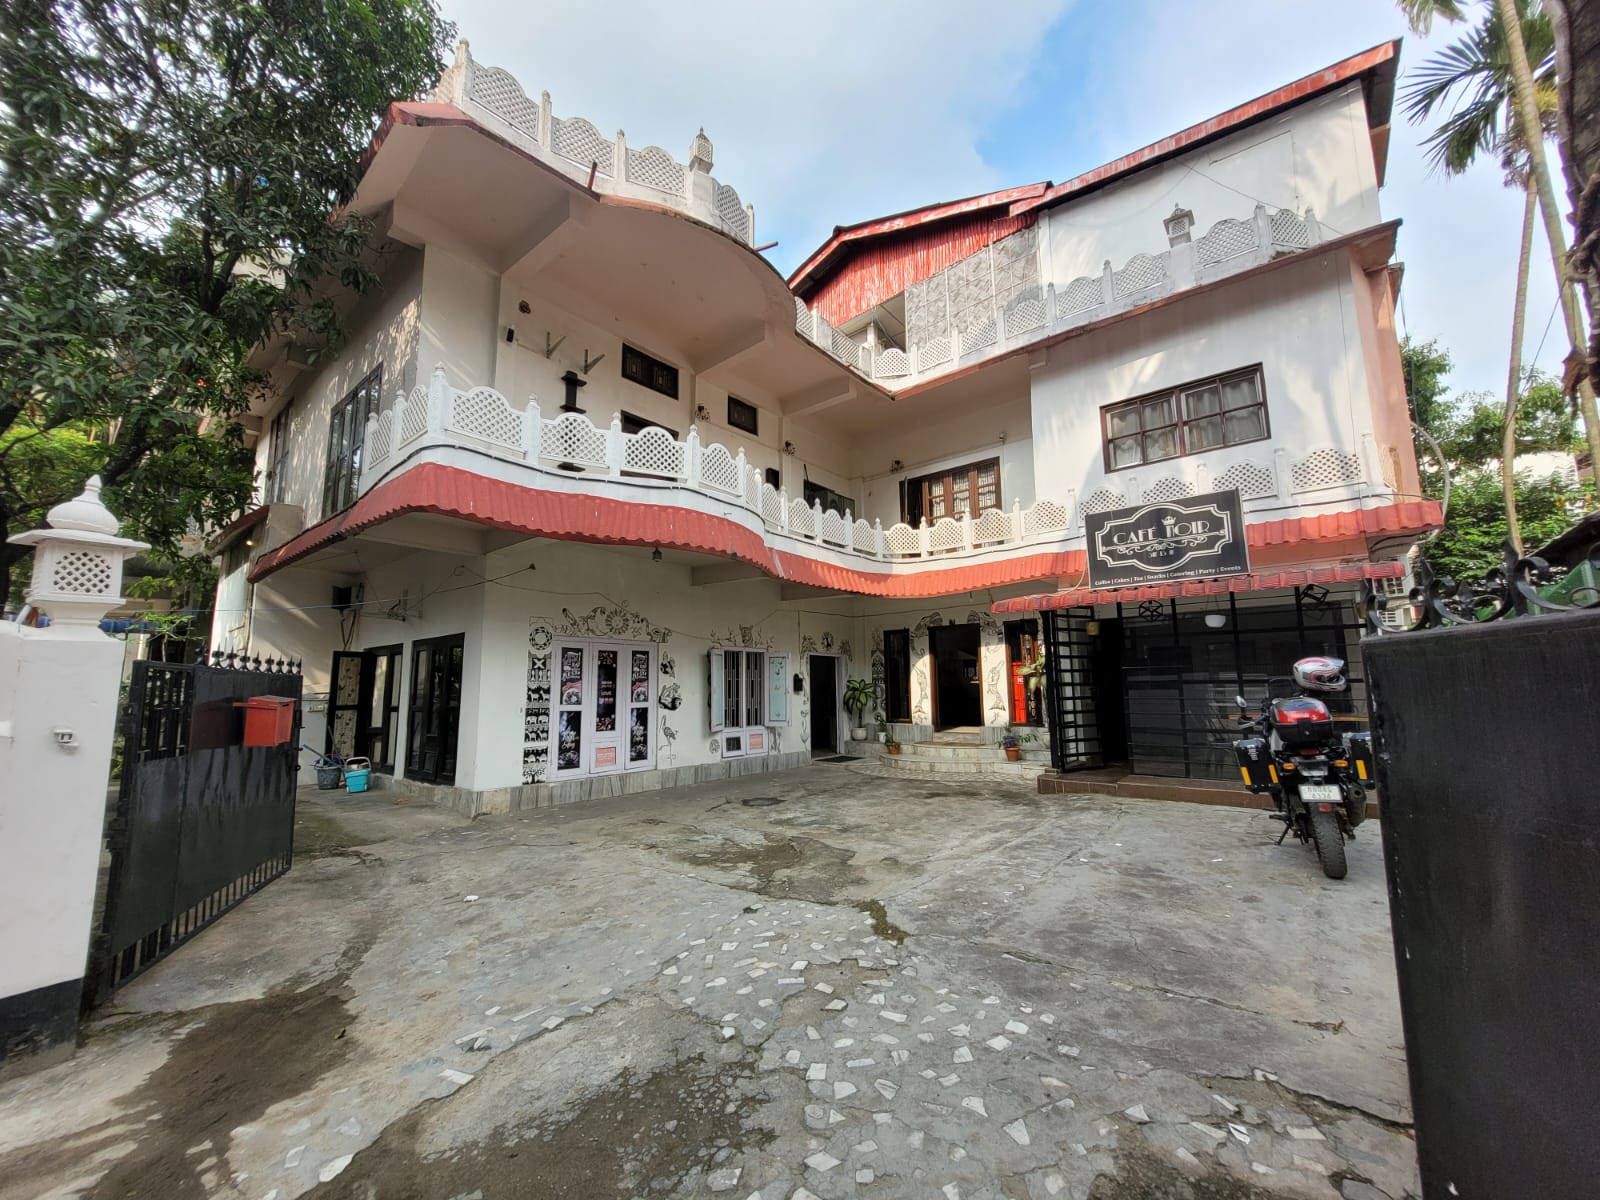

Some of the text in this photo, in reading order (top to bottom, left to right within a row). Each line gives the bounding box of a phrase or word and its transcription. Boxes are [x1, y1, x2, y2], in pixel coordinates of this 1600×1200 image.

[1147, 573, 1166, 581] Snacks
[1169, 570, 1195, 578] Catering
[1198, 567, 1215, 576] Party
[1220, 564, 1242, 572] Events
